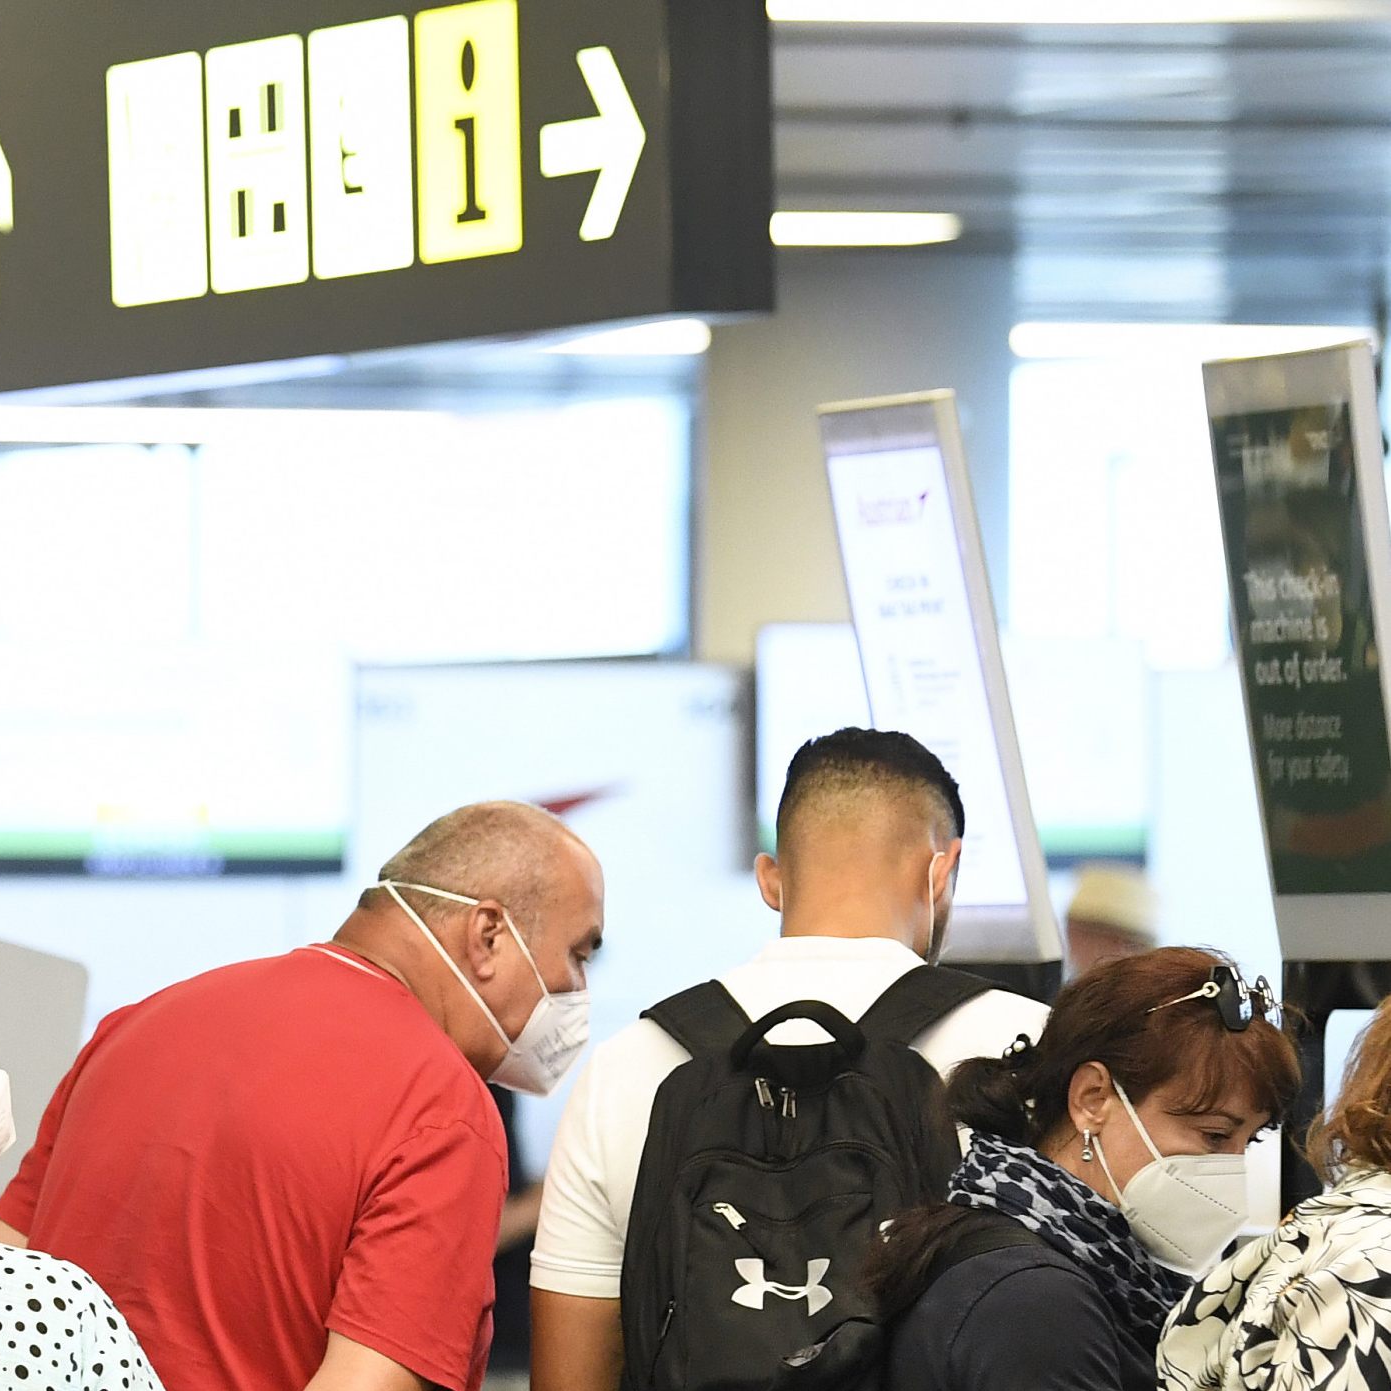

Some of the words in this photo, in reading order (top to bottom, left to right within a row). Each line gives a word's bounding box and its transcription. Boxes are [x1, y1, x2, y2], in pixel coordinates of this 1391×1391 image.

[1251, 611, 1313, 643] machine
[1255, 658, 1282, 686] out
[1283, 651, 1301, 690] of
